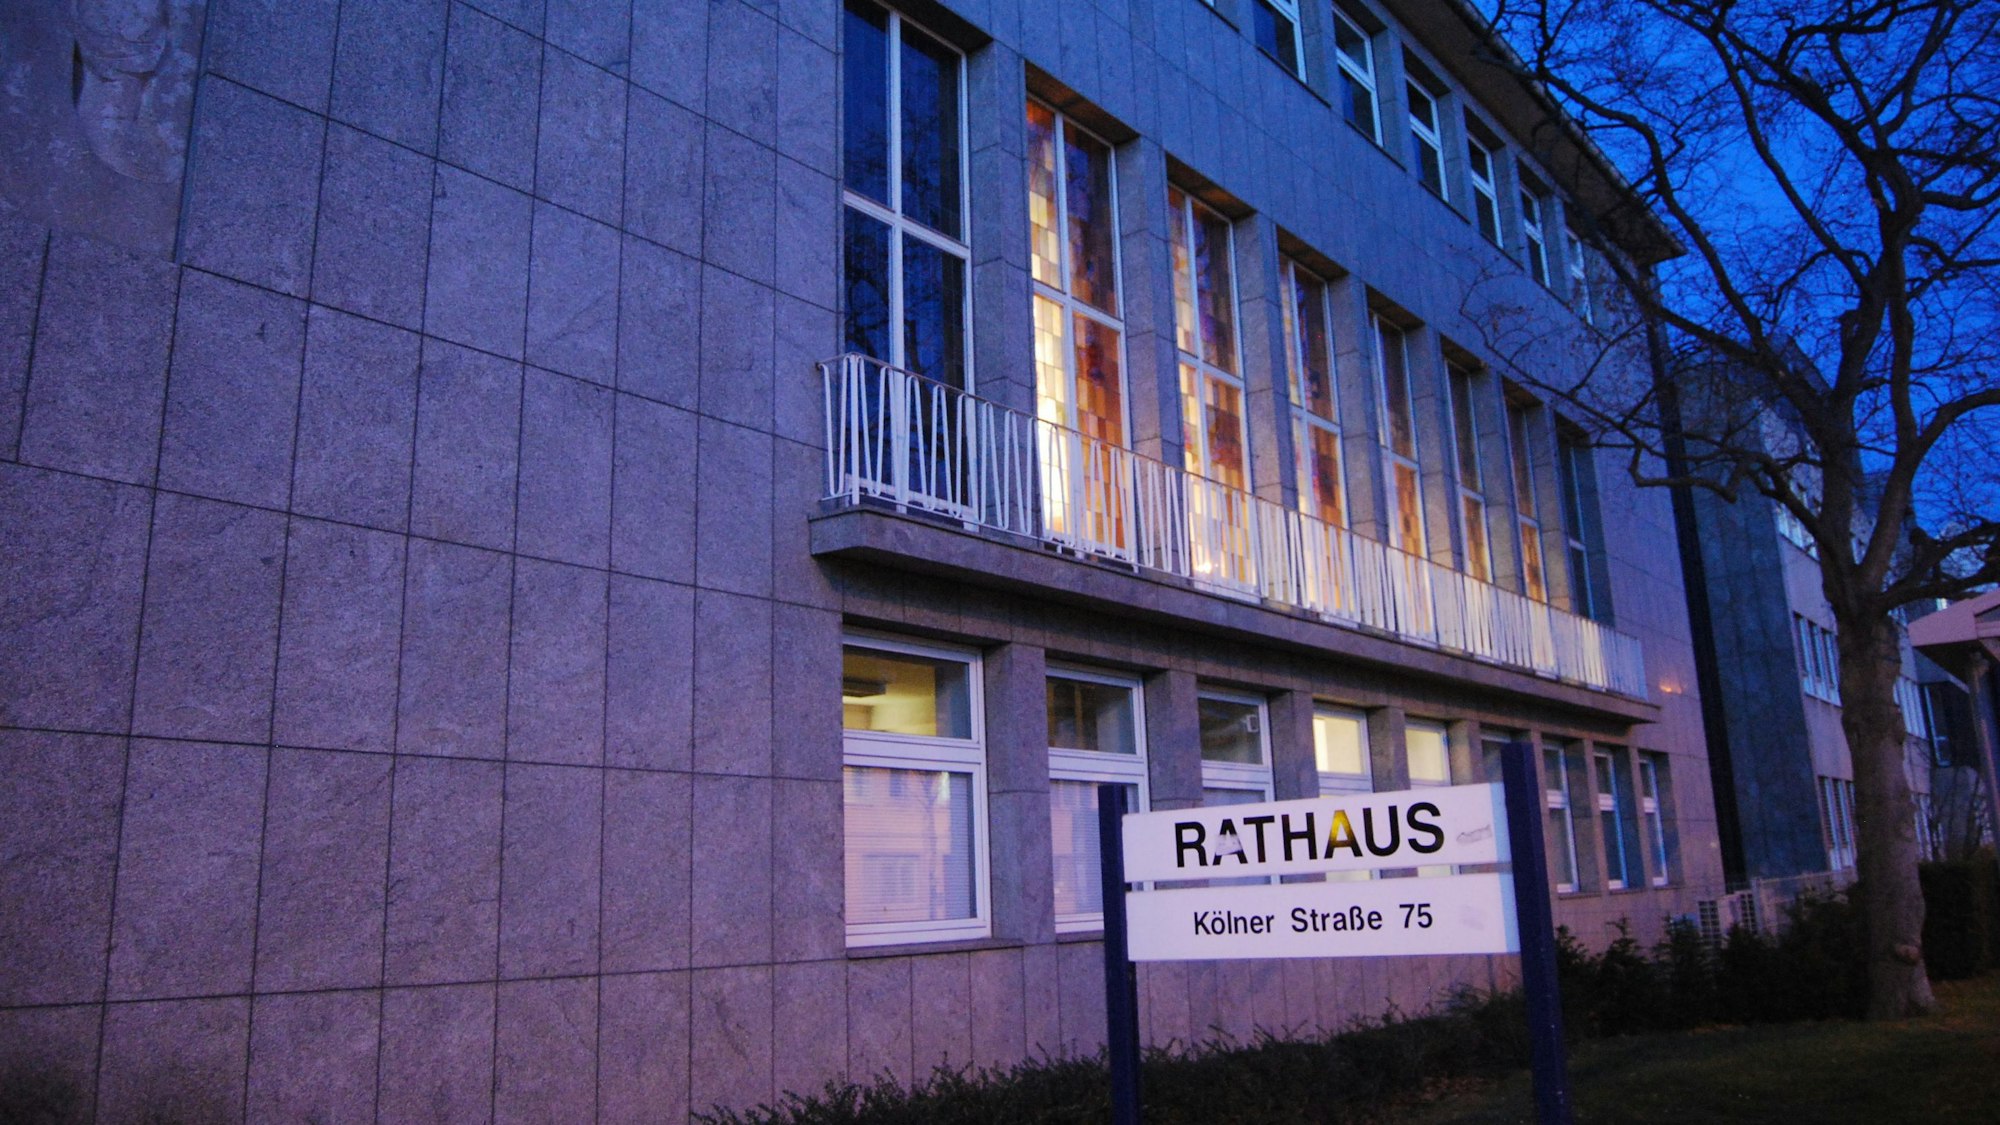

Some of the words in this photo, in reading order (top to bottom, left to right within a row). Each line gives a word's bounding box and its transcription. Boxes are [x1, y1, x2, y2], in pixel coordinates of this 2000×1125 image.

[1175, 801, 1445, 867] RATHAUS
[1193, 910, 1274, 935] Kölner
[1291, 905, 1383, 932] Straße
[1399, 903, 1433, 929] 75
